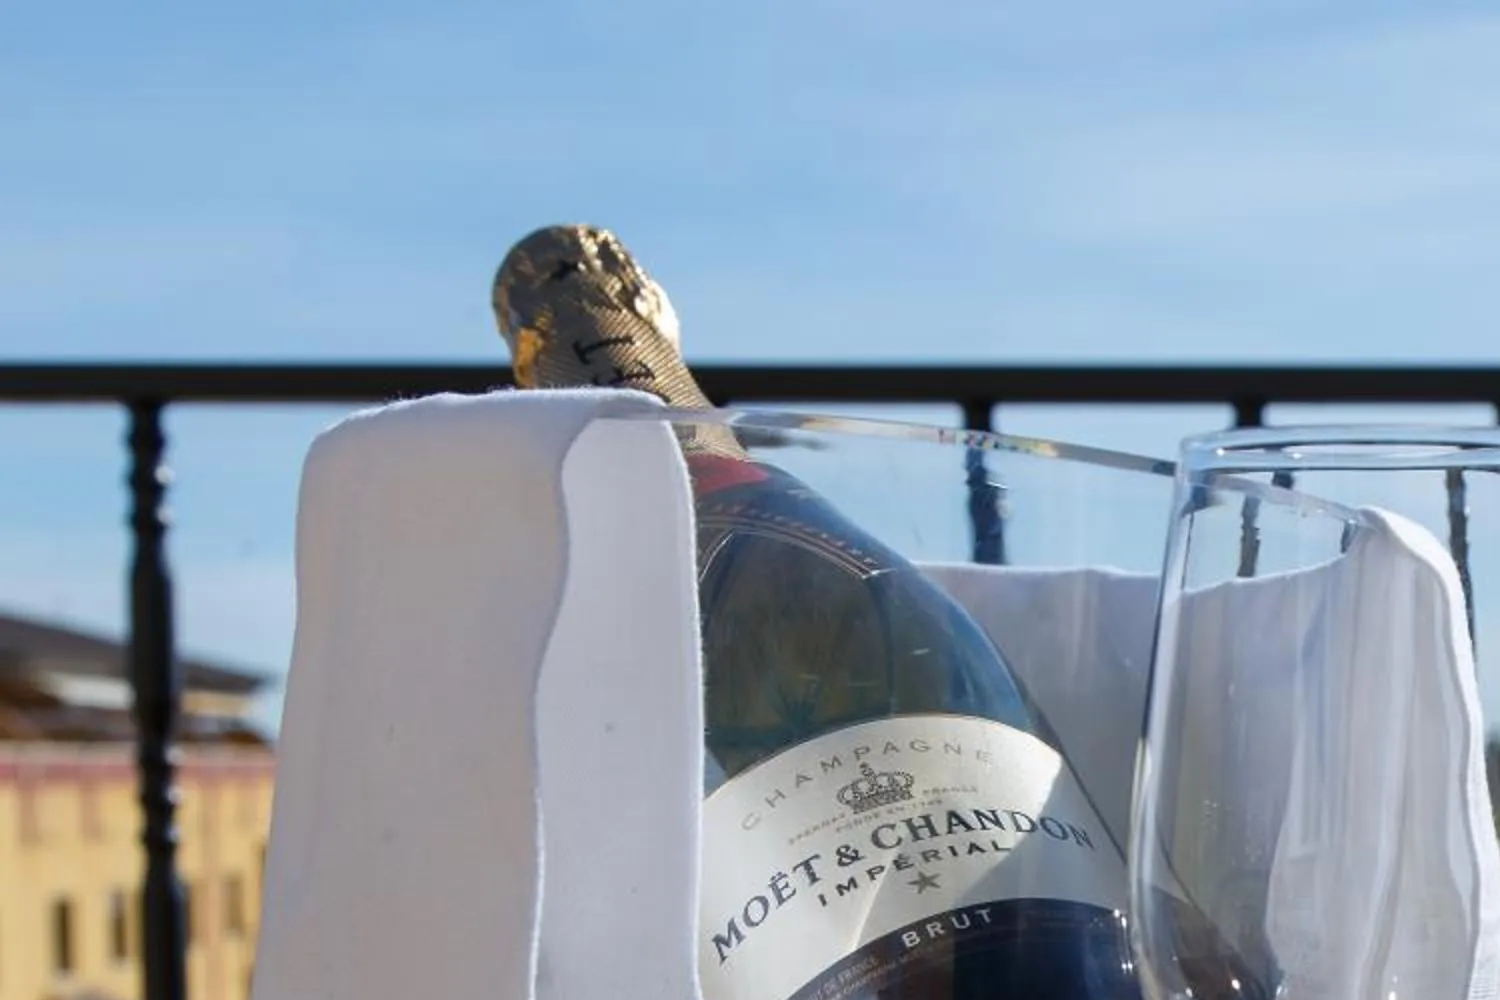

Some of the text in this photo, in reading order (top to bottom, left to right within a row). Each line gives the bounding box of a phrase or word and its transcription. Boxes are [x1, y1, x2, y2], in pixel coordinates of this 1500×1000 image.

[741, 738, 994, 832] CHAMPAGNE
[710, 852, 822, 966] MOËT
[835, 842, 864, 867] &
[870, 807, 1095, 852] CHANDON
[818, 840, 1013, 907] IMPÉRIAL
[901, 906, 994, 949] BRUT
